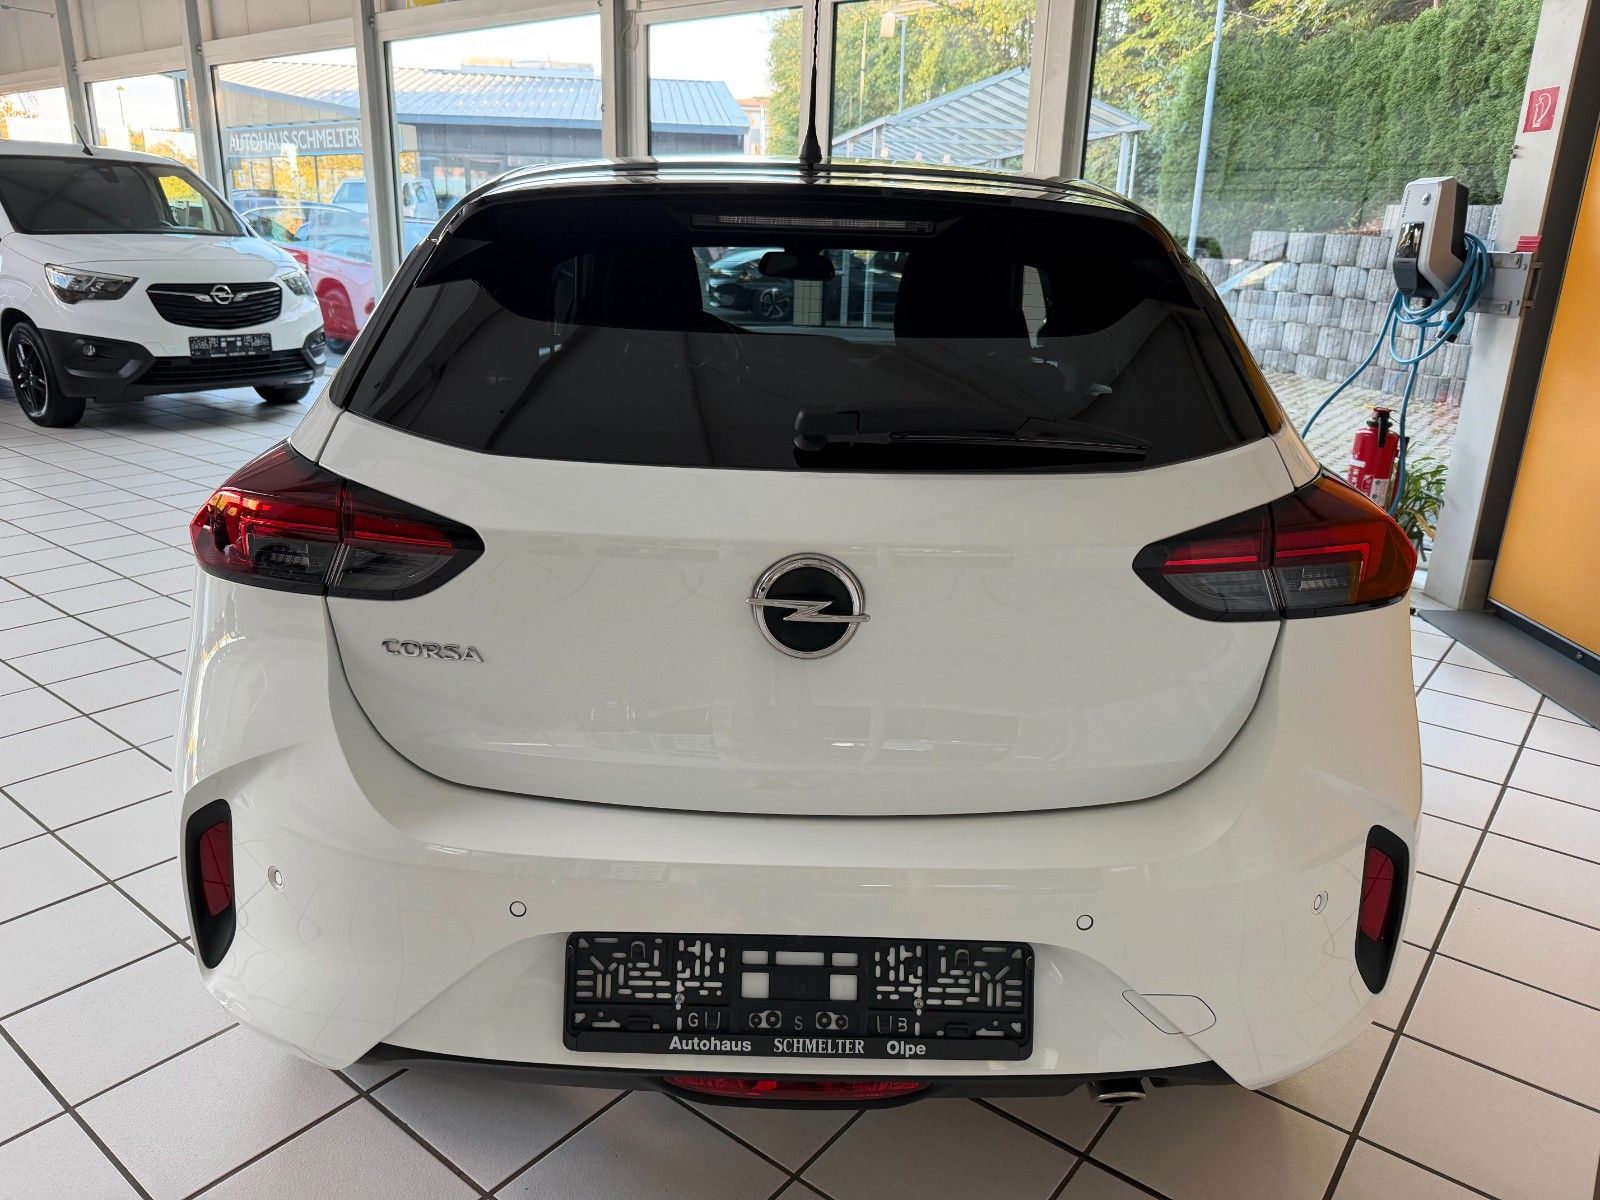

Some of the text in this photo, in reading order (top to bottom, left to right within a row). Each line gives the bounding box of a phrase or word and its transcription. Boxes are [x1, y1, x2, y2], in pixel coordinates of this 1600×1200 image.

[229, 127, 362, 152] AUTOHAUS SCHMELTER
[381, 638, 485, 663] CORSA
[669, 1035, 927, 1058] Autohaus SCHMELTER Olpe
